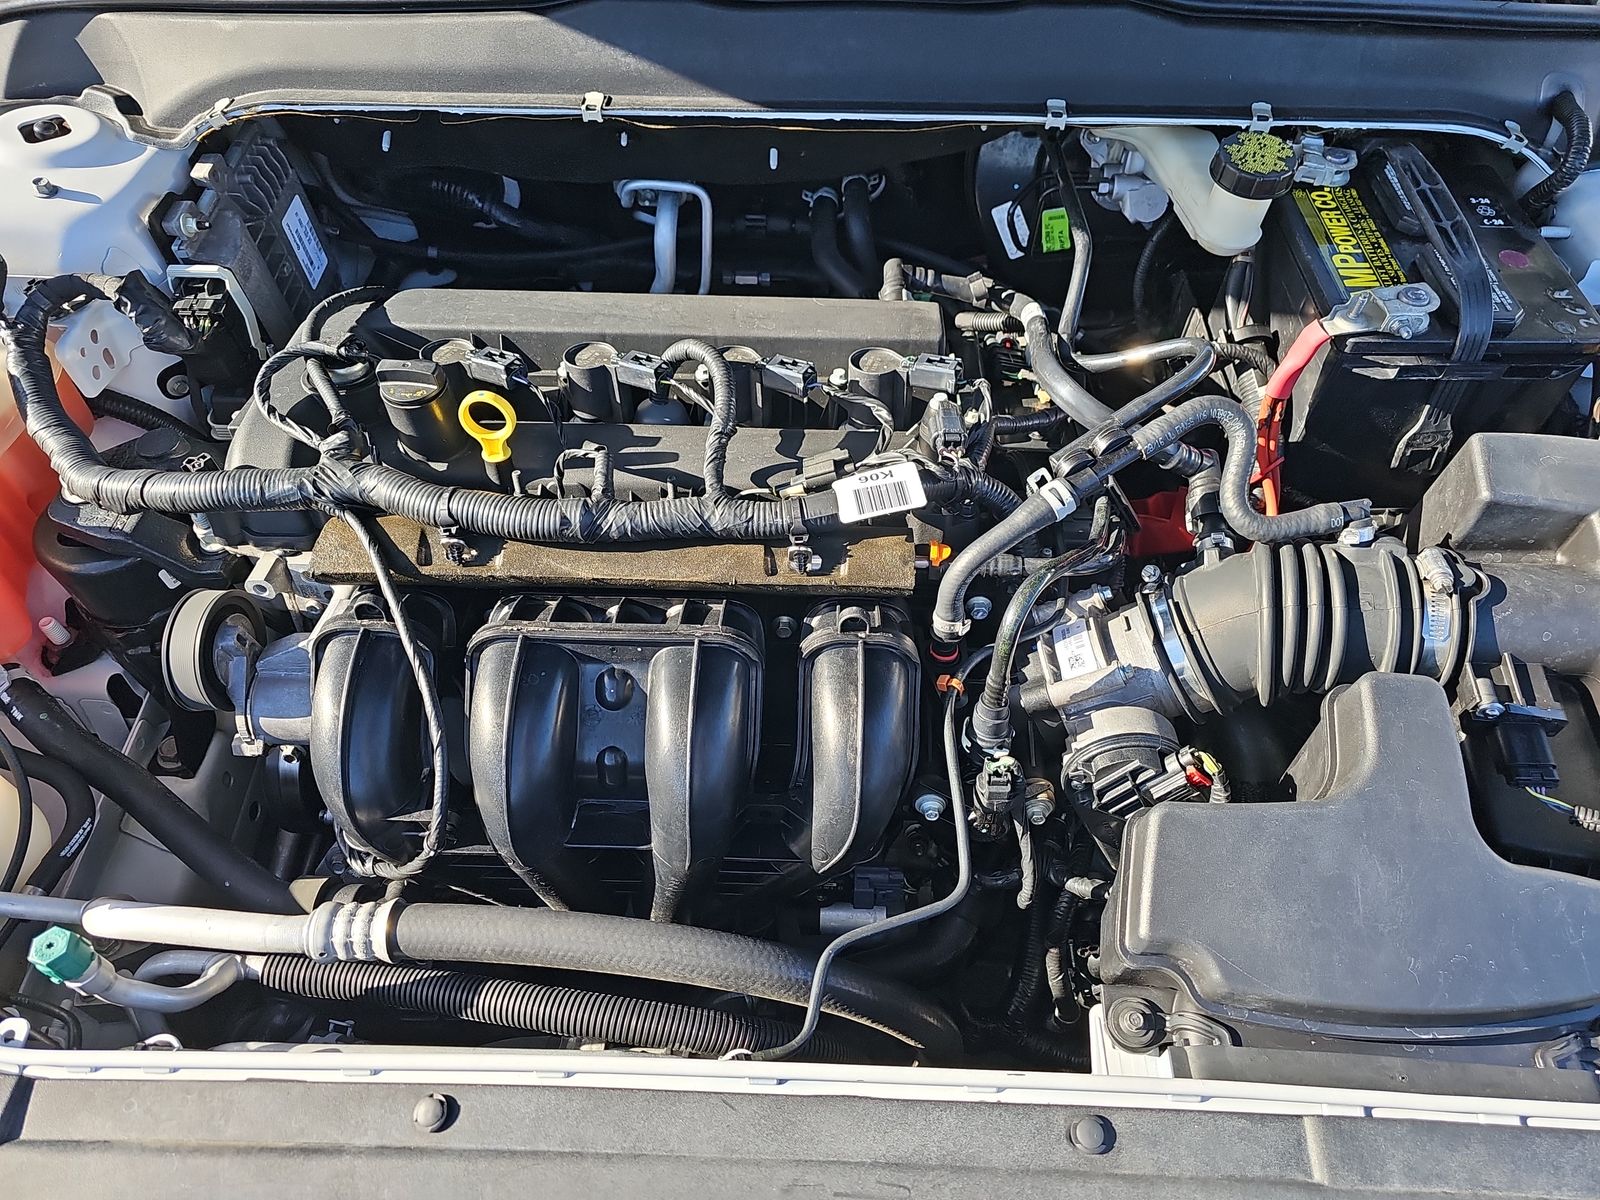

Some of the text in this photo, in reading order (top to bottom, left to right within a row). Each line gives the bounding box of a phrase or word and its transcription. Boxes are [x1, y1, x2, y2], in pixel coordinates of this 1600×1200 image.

[1334, 187, 1358, 222] CHARGERS
[1310, 187, 1380, 287] MP POWER CO.
[1358, 229, 1382, 266] BATTERIES
[858, 469, 895, 484] K06
[1330, 516, 1344, 528] DOT
